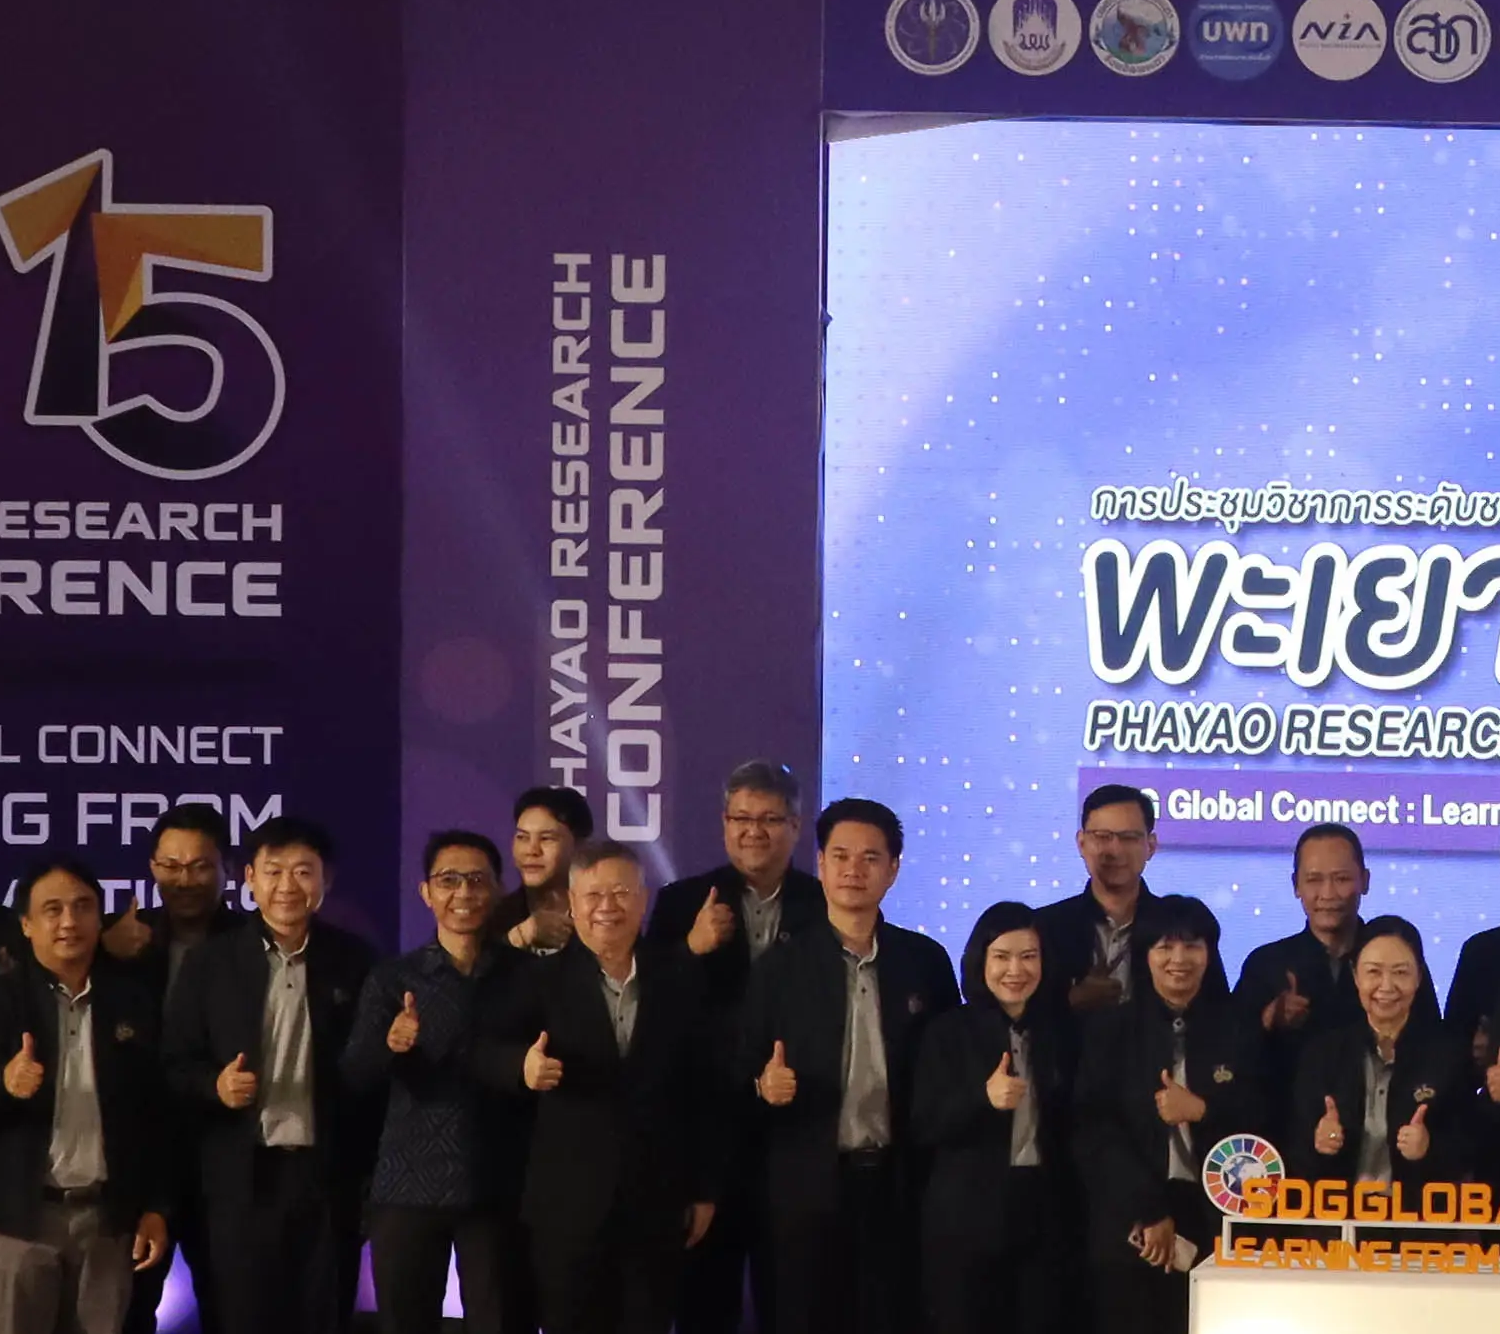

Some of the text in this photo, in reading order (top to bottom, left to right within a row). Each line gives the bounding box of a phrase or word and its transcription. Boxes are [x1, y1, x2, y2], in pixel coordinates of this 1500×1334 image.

[551, 253, 592, 578] RESEARCH
[606, 254, 667, 842] CONFERENCE
[39, 726, 284, 765] CONNECT
[1085, 704, 1272, 754] PHAYAO
[1168, 788, 1263, 821] Global
[1271, 791, 1399, 824] Connect
[1214, 1236, 1392, 1273] LEARNING
[1399, 1240, 1499, 1274] FROM
